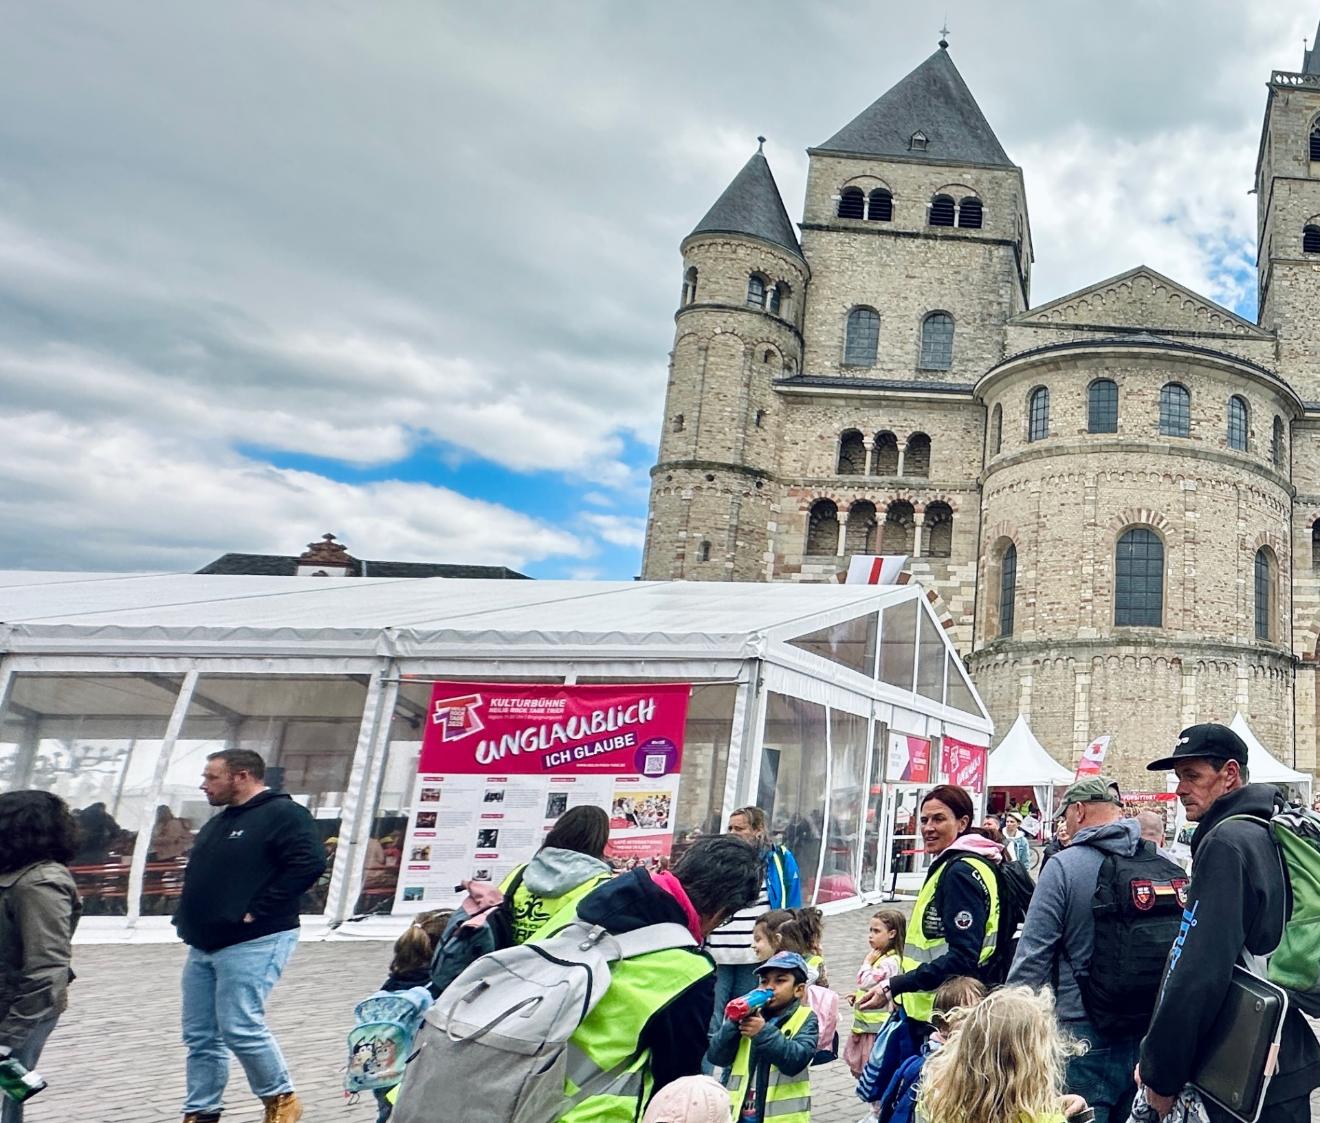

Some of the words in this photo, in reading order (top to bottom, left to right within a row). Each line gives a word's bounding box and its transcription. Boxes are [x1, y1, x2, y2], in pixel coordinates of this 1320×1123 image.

[490, 697, 567, 708] KULTURBÜHNE
[545, 749, 571, 768] ICH
[573, 733, 636, 759] GLAUBE
